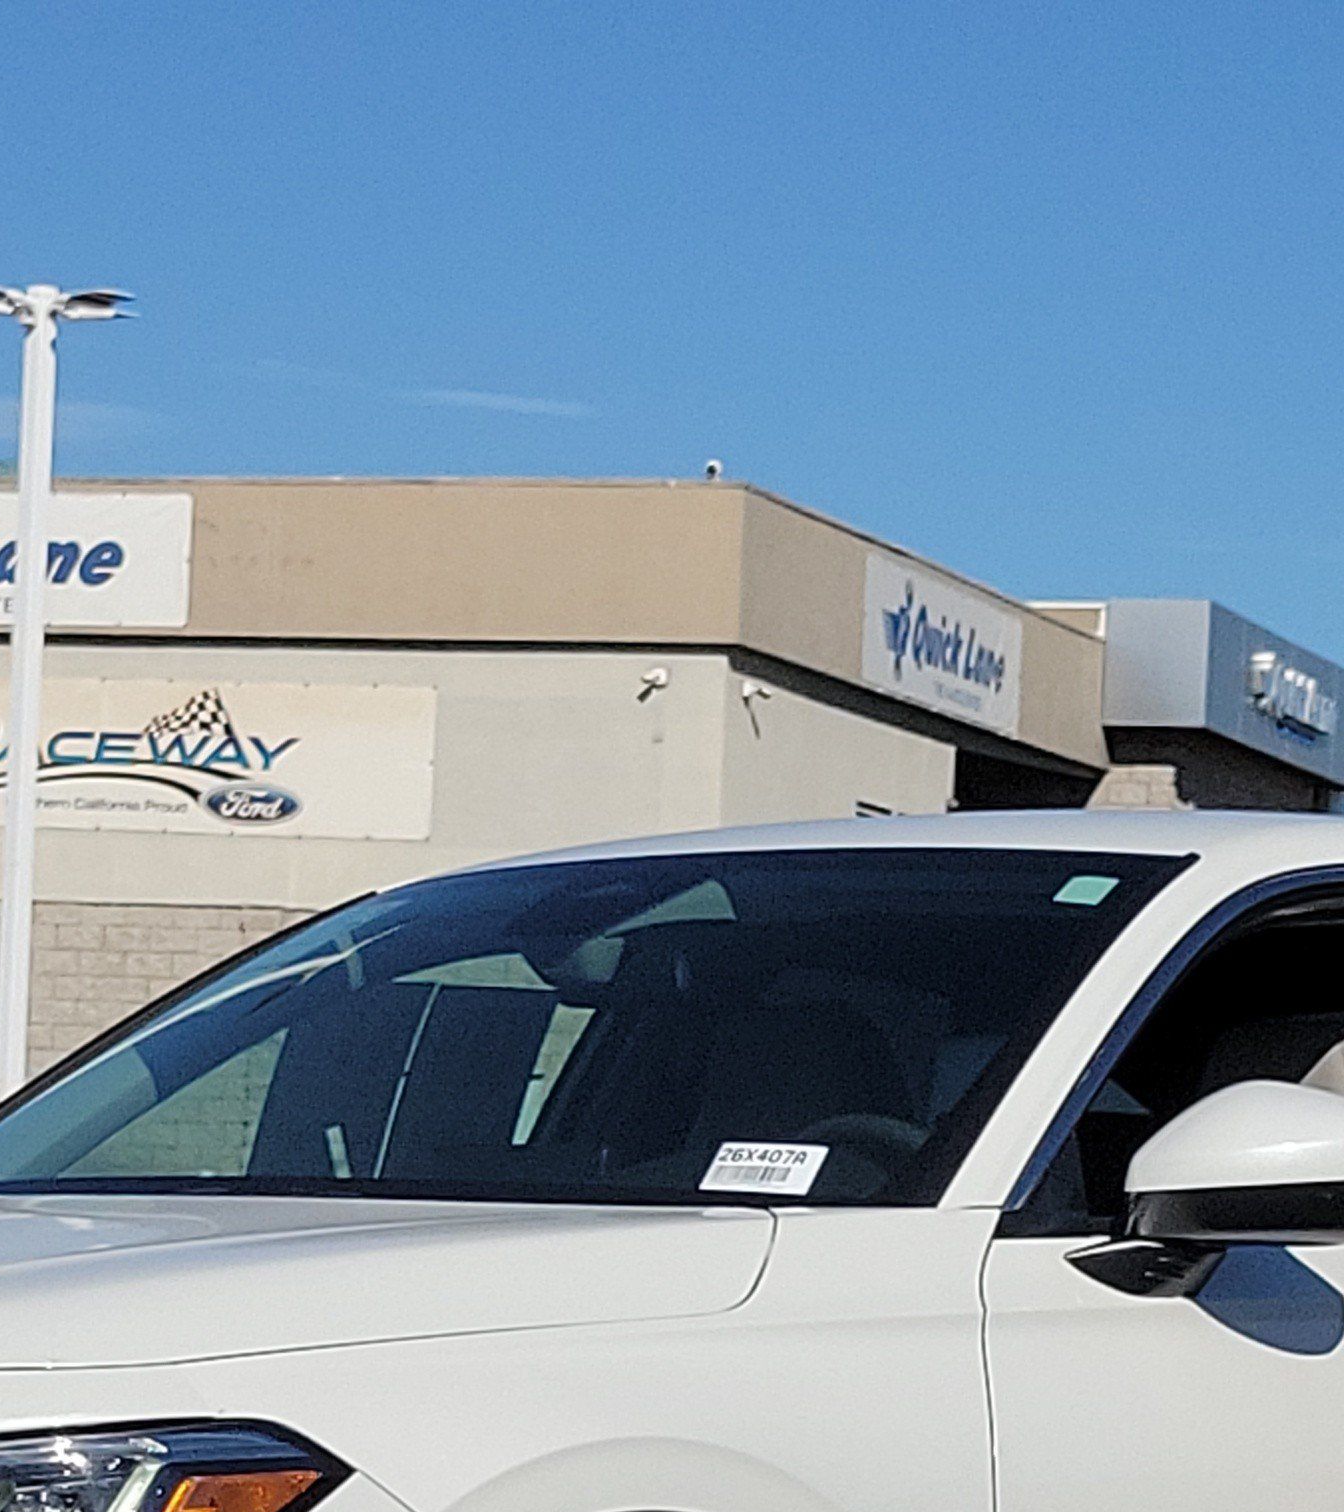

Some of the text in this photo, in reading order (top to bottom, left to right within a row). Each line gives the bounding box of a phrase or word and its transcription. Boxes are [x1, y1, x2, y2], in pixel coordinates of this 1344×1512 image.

[74, 797, 141, 811] California
[219, 789, 284, 820] Ford
[718, 1147, 809, 1166] 26X407A
